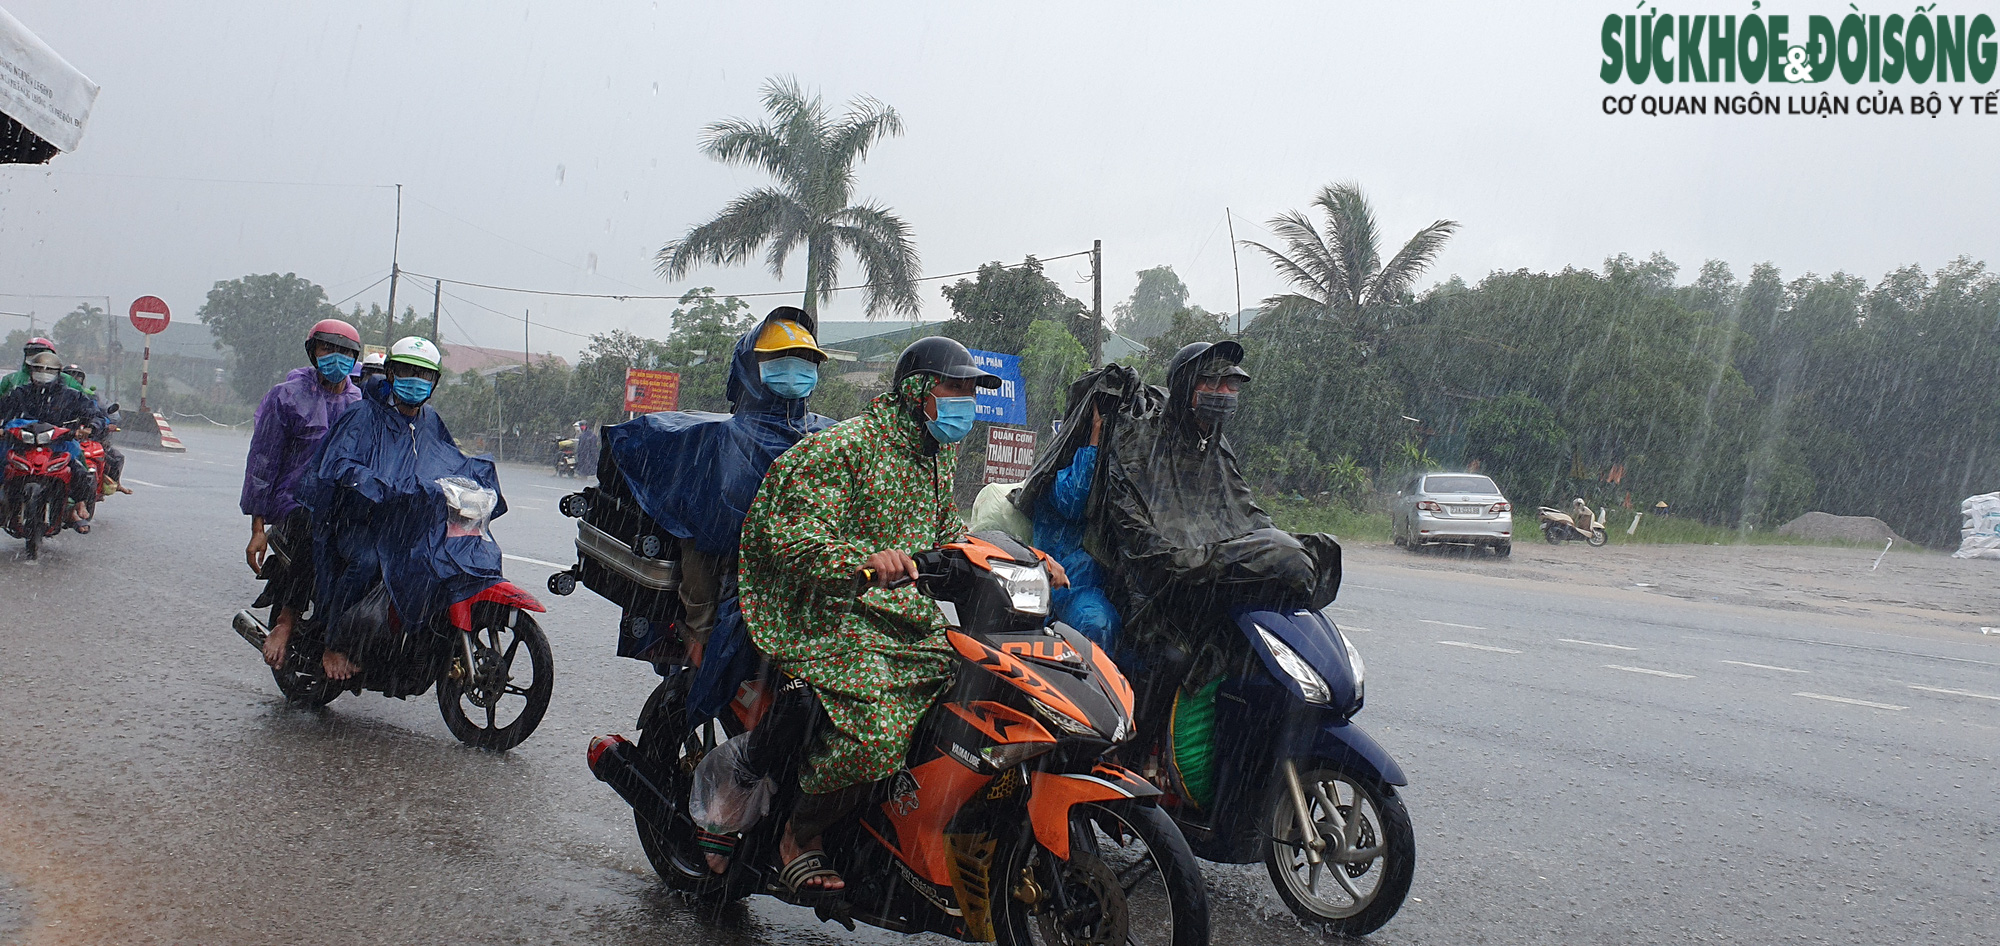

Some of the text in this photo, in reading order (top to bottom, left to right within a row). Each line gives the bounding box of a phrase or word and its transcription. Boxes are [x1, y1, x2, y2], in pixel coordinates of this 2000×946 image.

[986, 356, 1003, 369] PHẬN
[1001, 379, 1015, 402] TRỊ
[1015, 433, 1033, 443] CƠM
[988, 442, 1034, 466] THÀNH LONG
[1006, 467, 1015, 477] CÁC
[951, 740, 981, 768] YAMALUBE
